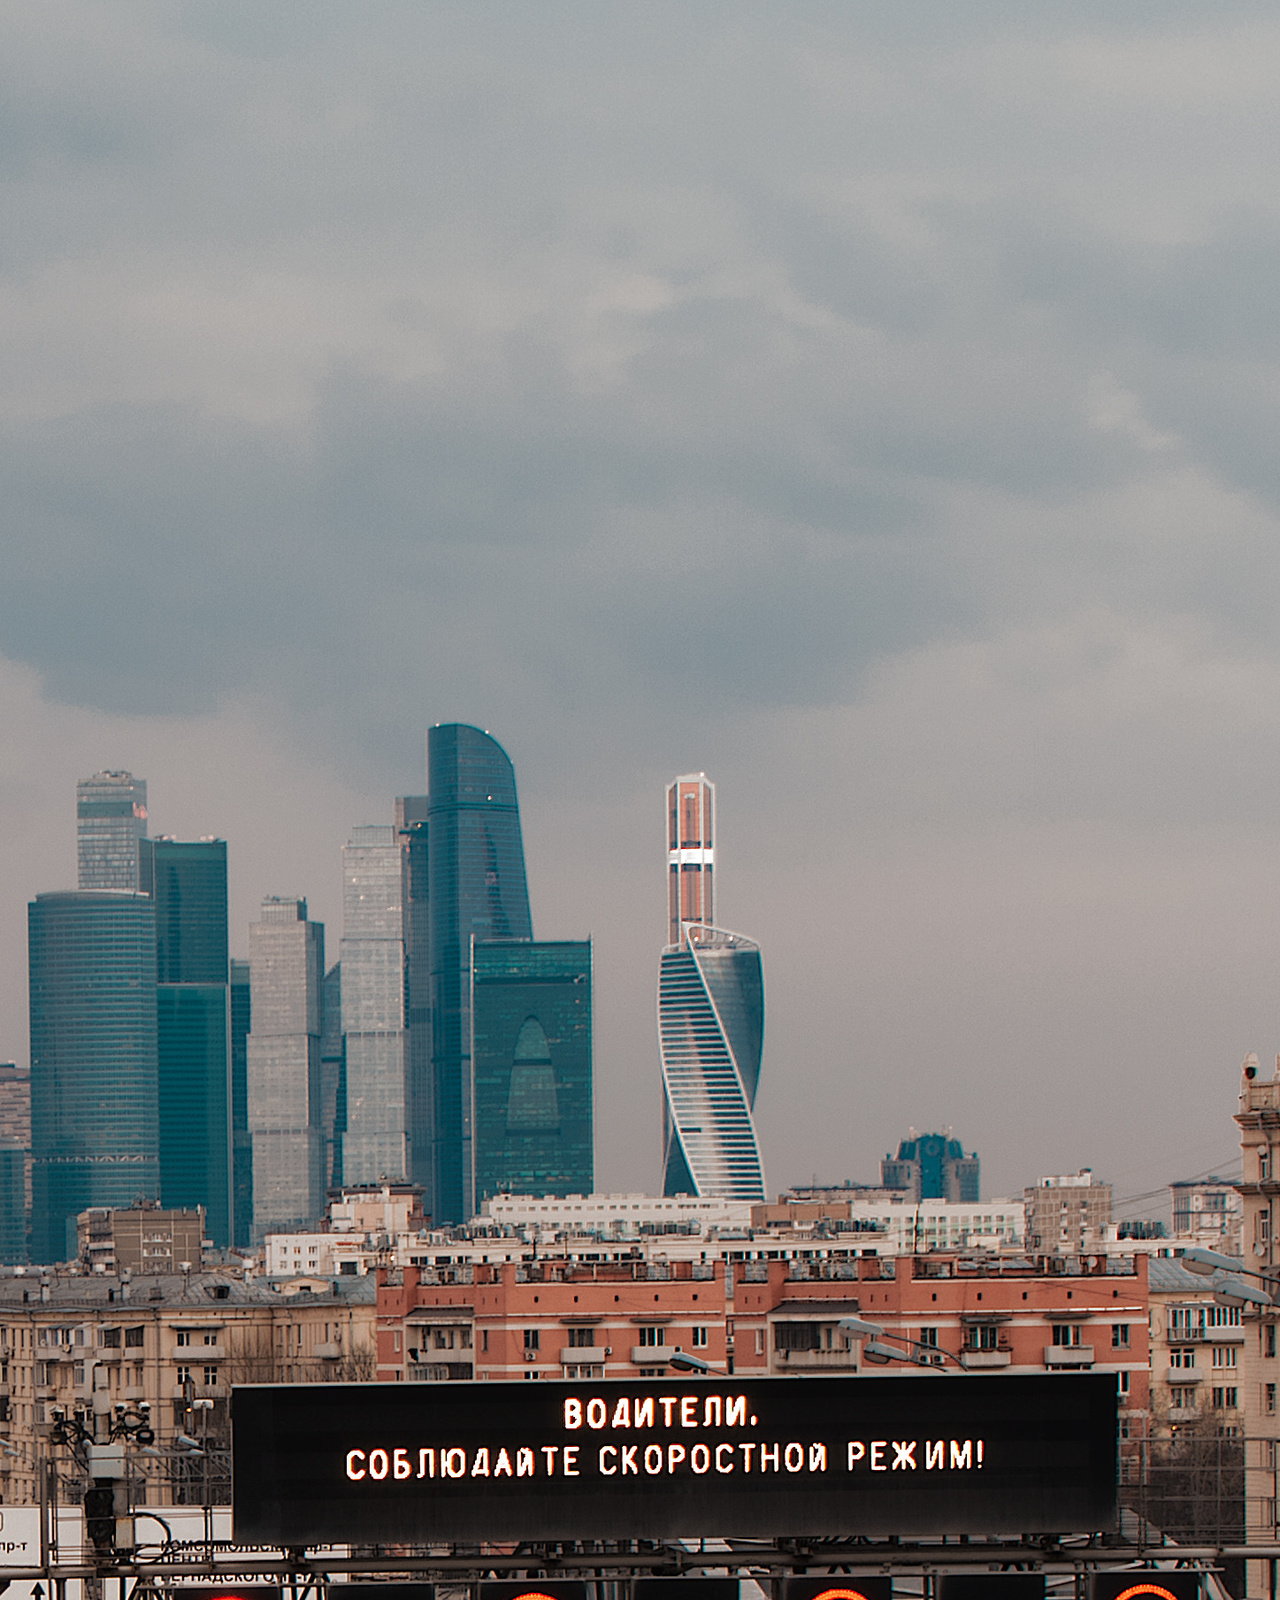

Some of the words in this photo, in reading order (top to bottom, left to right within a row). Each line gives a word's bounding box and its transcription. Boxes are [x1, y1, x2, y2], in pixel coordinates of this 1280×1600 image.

[346, 1446, 581, 1480] СОБЛЮДАЙТЕ
[599, 1442, 828, 1475] СКОРОСТНОЙ
[847, 1439, 985, 1471] РЕЖИМ!
